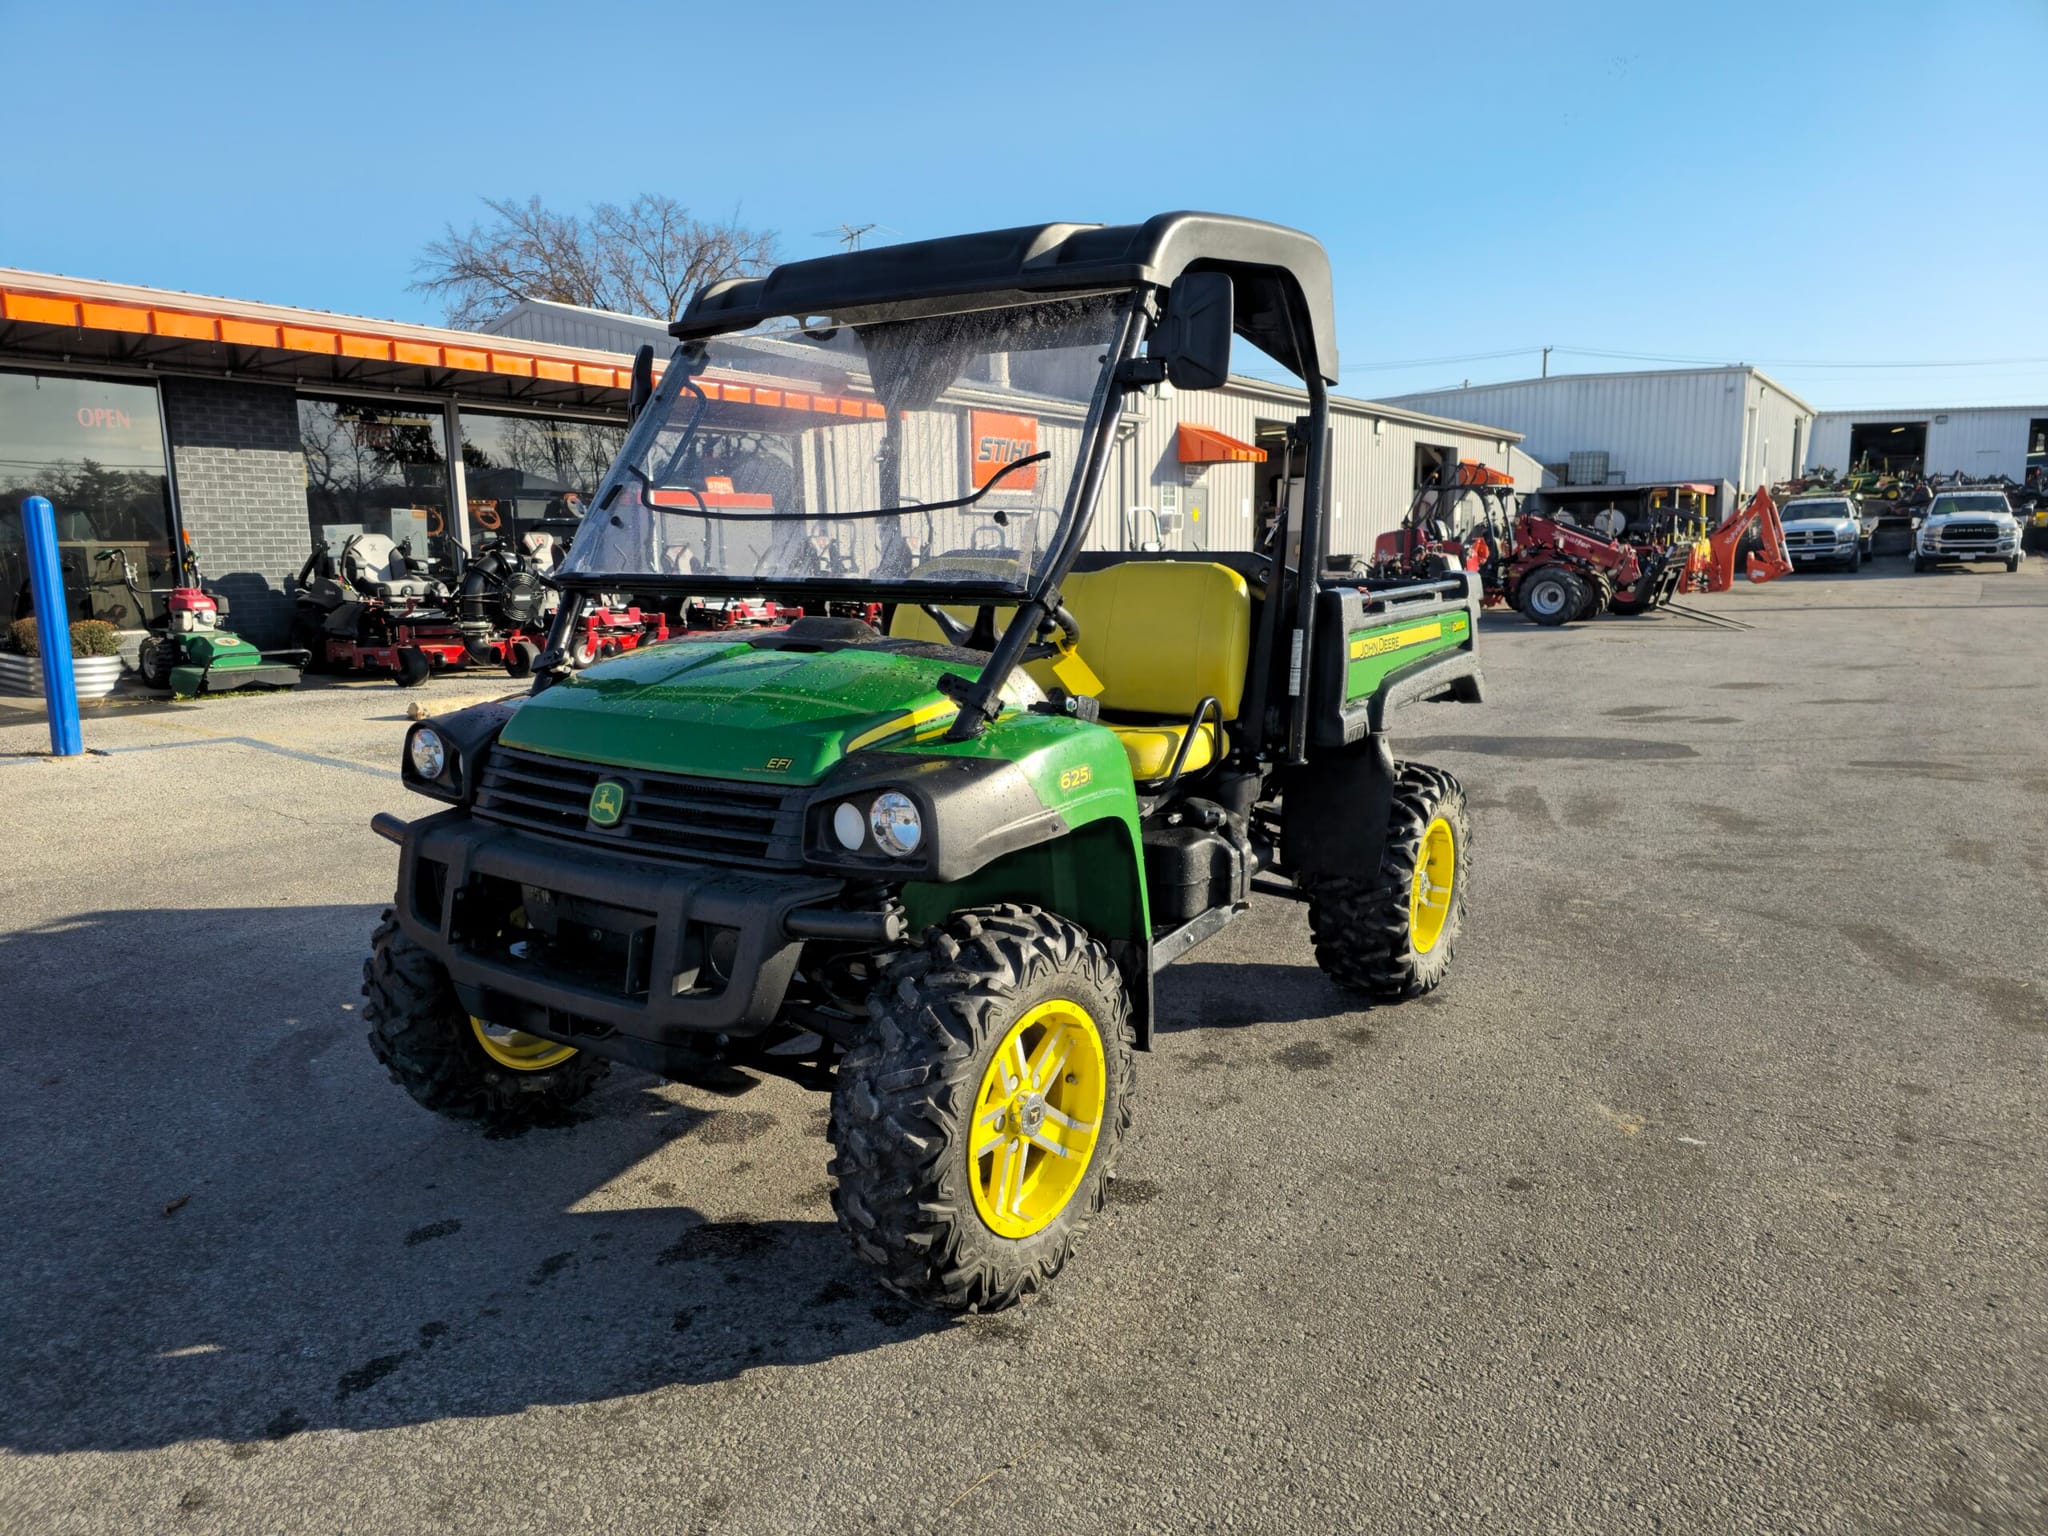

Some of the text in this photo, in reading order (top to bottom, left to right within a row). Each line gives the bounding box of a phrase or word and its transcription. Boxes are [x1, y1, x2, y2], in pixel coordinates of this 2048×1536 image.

[77, 407, 131, 430] OPEN
[1360, 636, 1400, 656] JOHN DEERE
[767, 758, 792, 769] EFI
